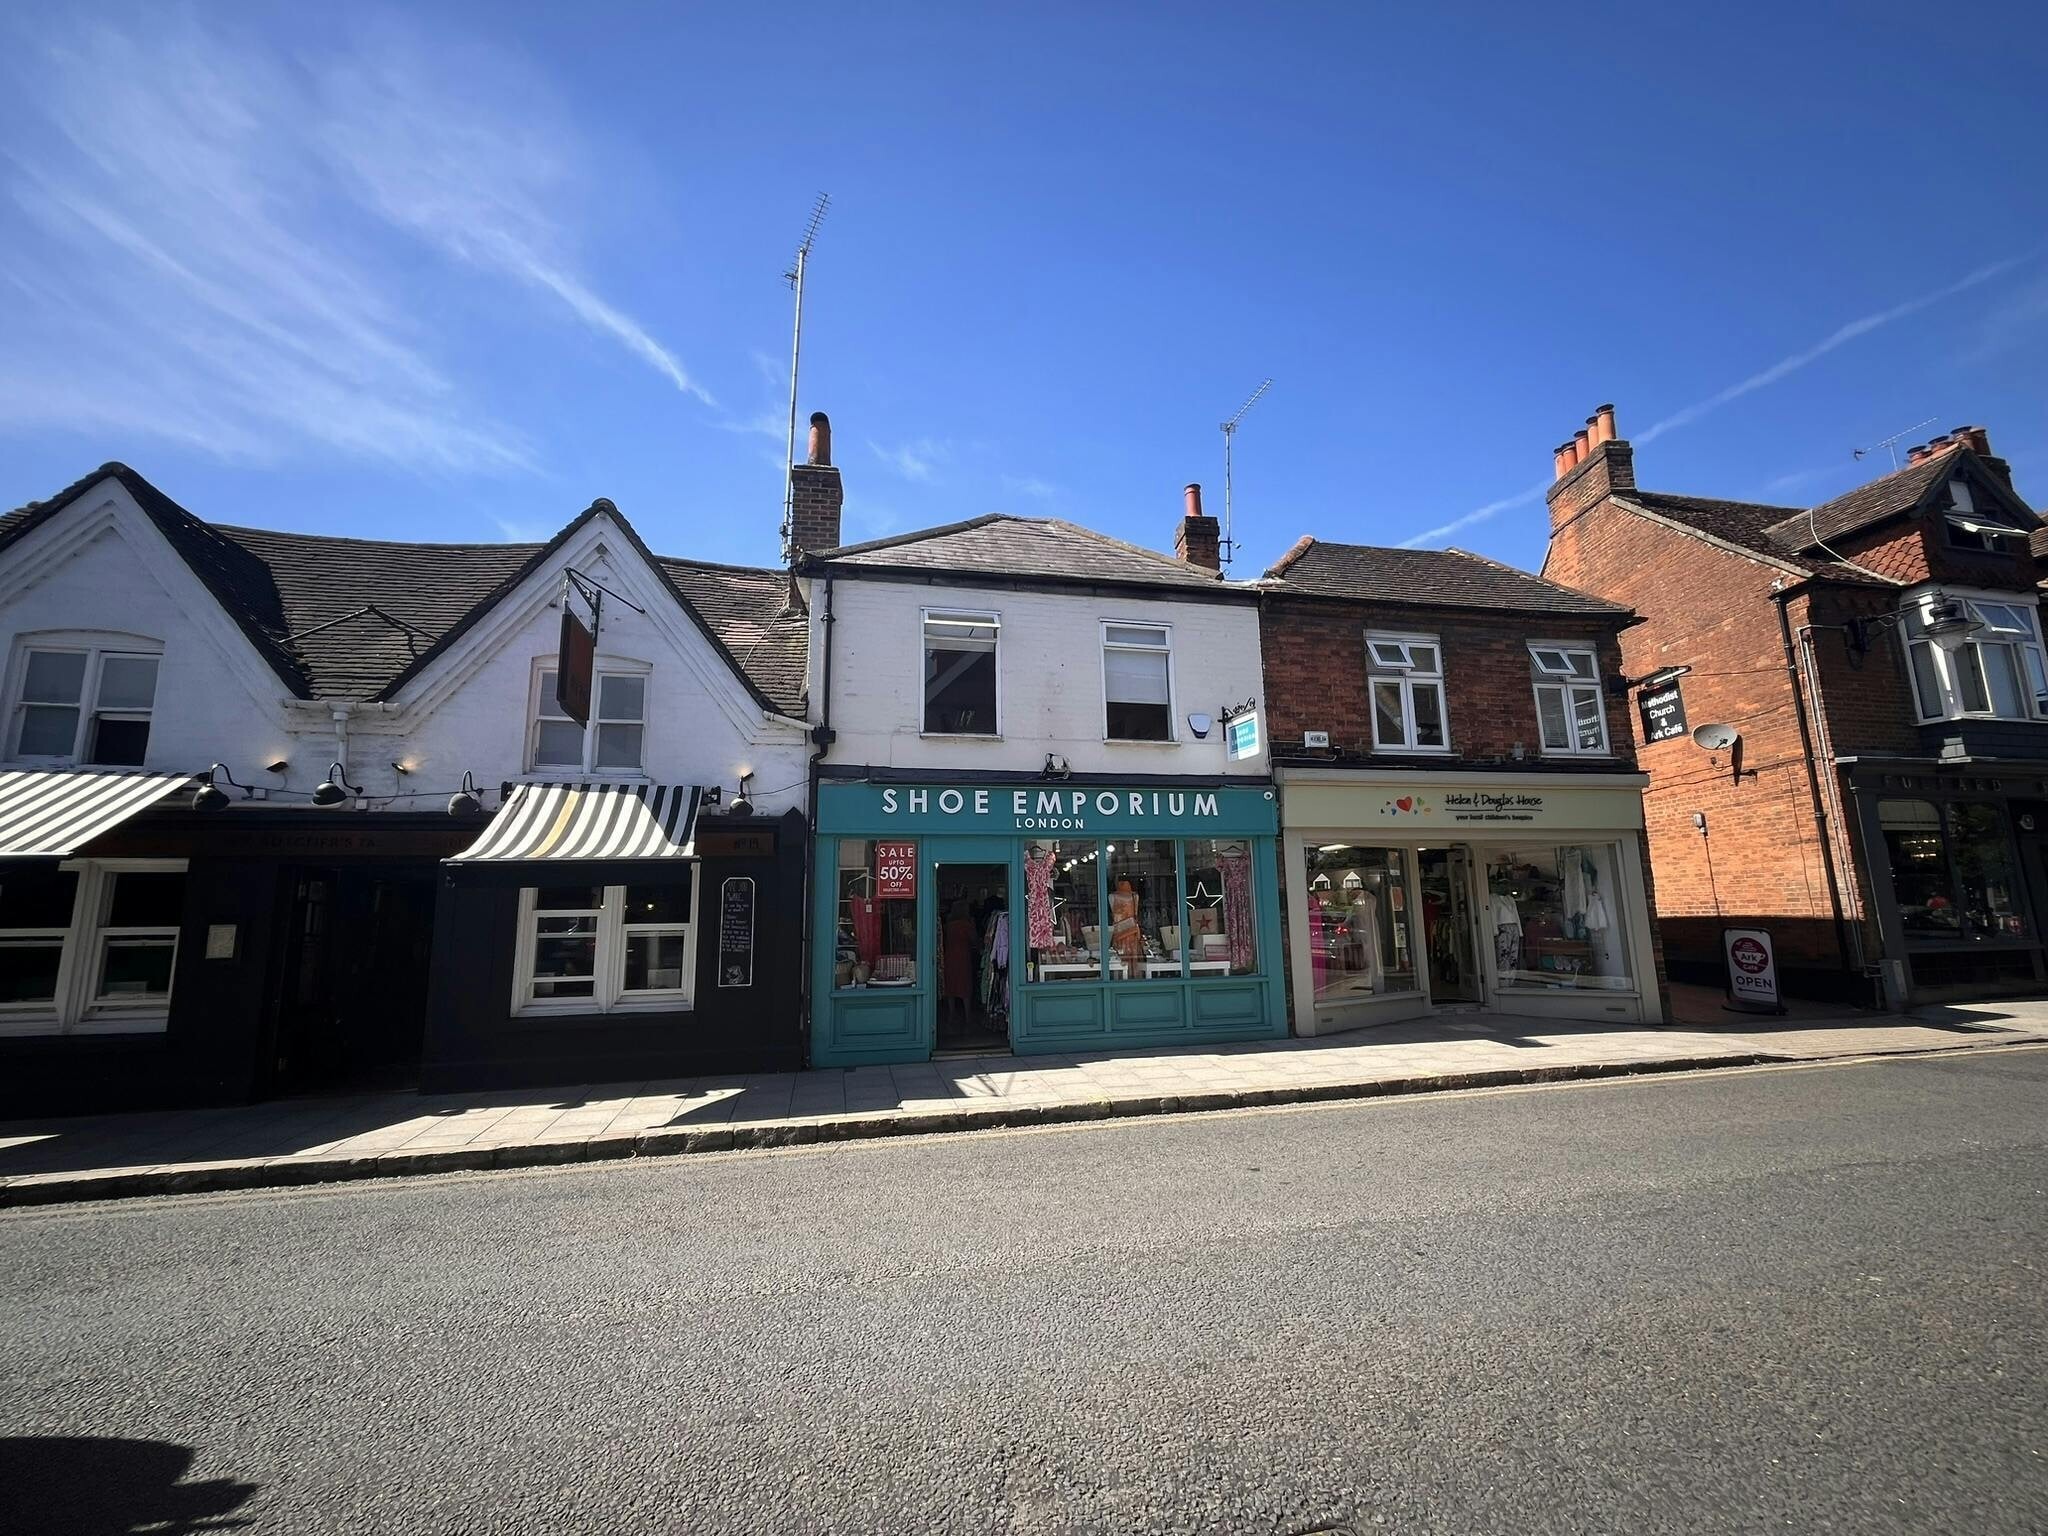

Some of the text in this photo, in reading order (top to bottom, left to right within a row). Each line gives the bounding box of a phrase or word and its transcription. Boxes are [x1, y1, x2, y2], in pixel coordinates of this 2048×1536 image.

[1641, 690, 1679, 710] Methodist
[1649, 704, 1676, 719] Church
[1660, 717, 1668, 727] &
[1651, 723, 1683, 740] Ark Café
[881, 788, 1219, 816] SHOE EMPORIUM
[1445, 793, 1471, 805] Helen
[1480, 793, 1514, 812] Douglas
[1516, 794, 1543, 806] House
[1016, 817, 1085, 829] LONDON
[880, 848, 913, 857] SALE
[880, 866, 913, 880] 50%
[1740, 953, 1758, 962] Ark
[1735, 975, 1772, 989] OPEN
